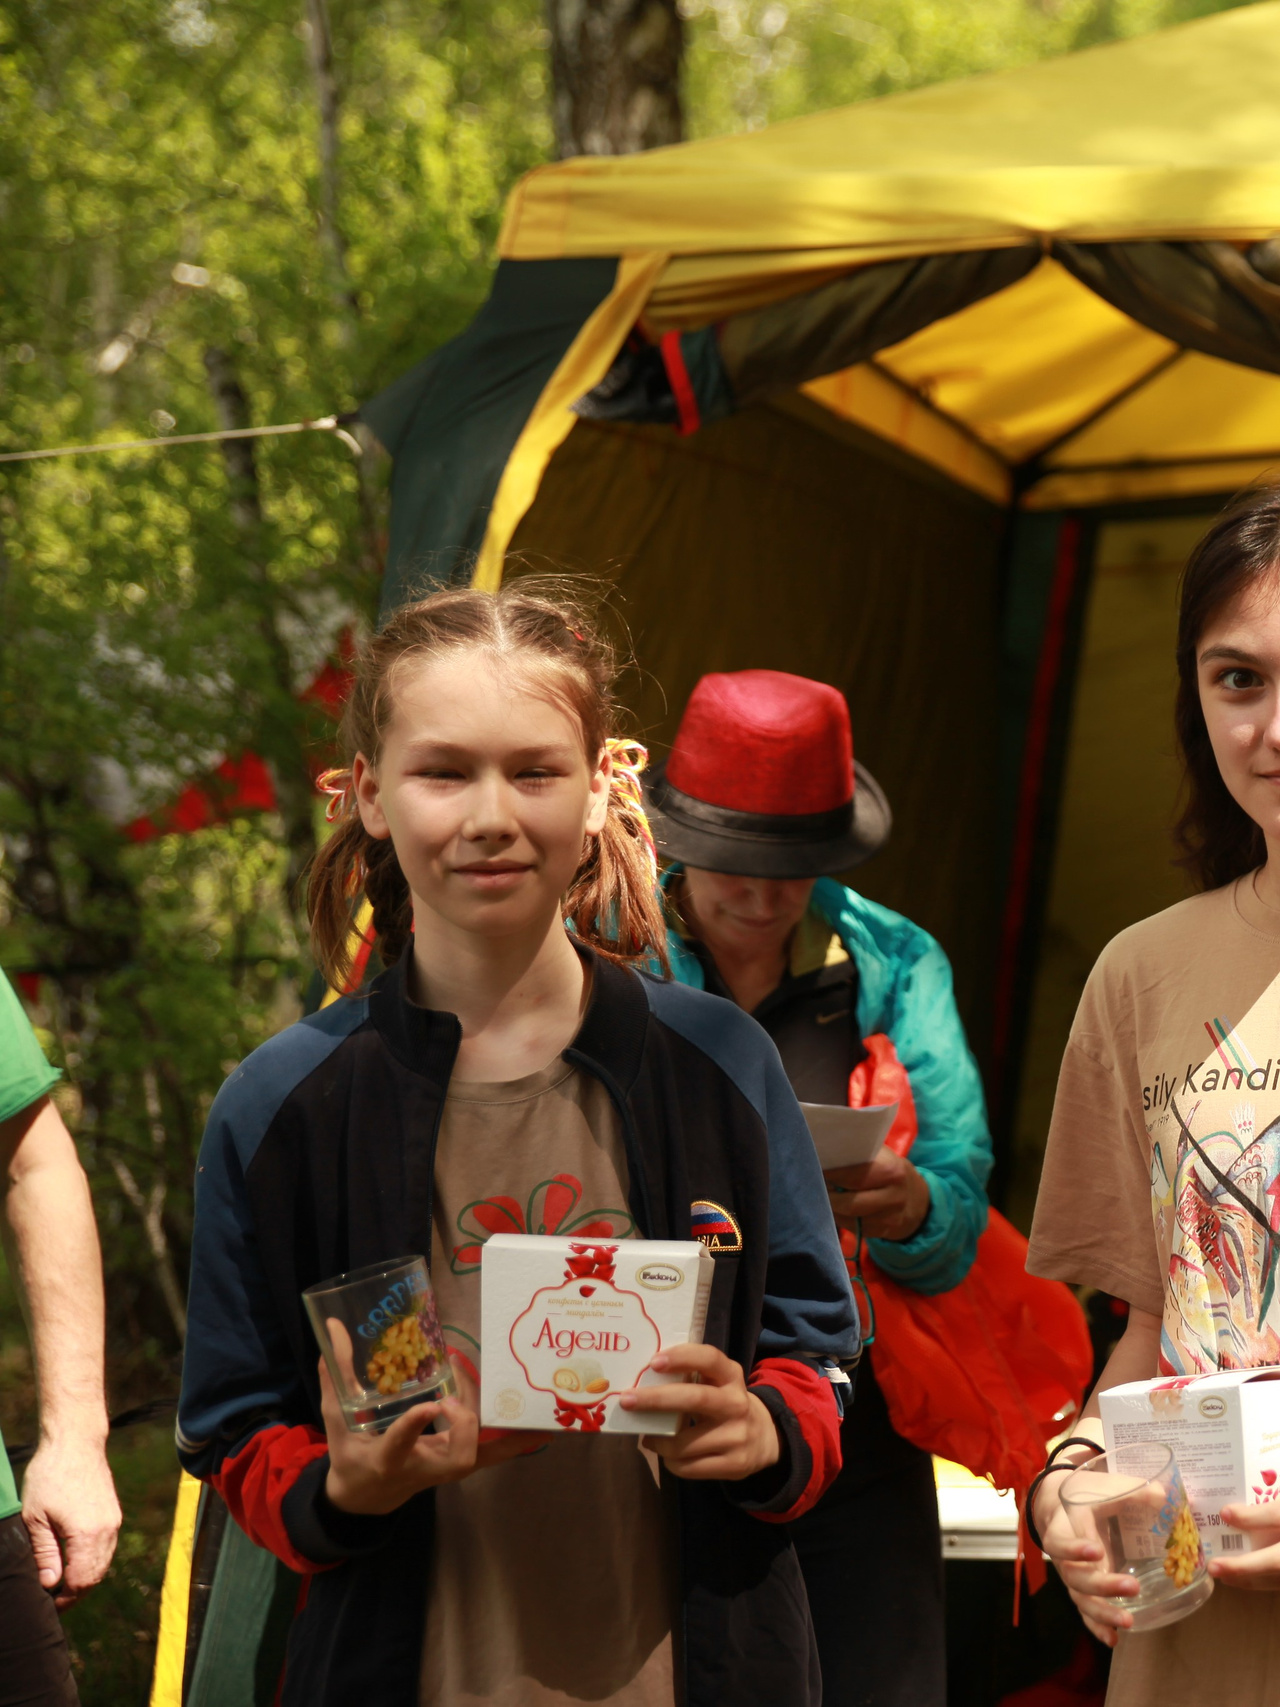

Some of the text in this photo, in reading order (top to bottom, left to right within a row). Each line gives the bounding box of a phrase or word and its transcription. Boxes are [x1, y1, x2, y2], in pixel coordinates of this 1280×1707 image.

[1143, 1073, 1177, 1112] sily
[696, 1233, 721, 1248] SIA
[547, 1296, 583, 1308] конфеты
[532, 1317, 631, 1359] Адель
[1207, 1513, 1221, 1526] 150
